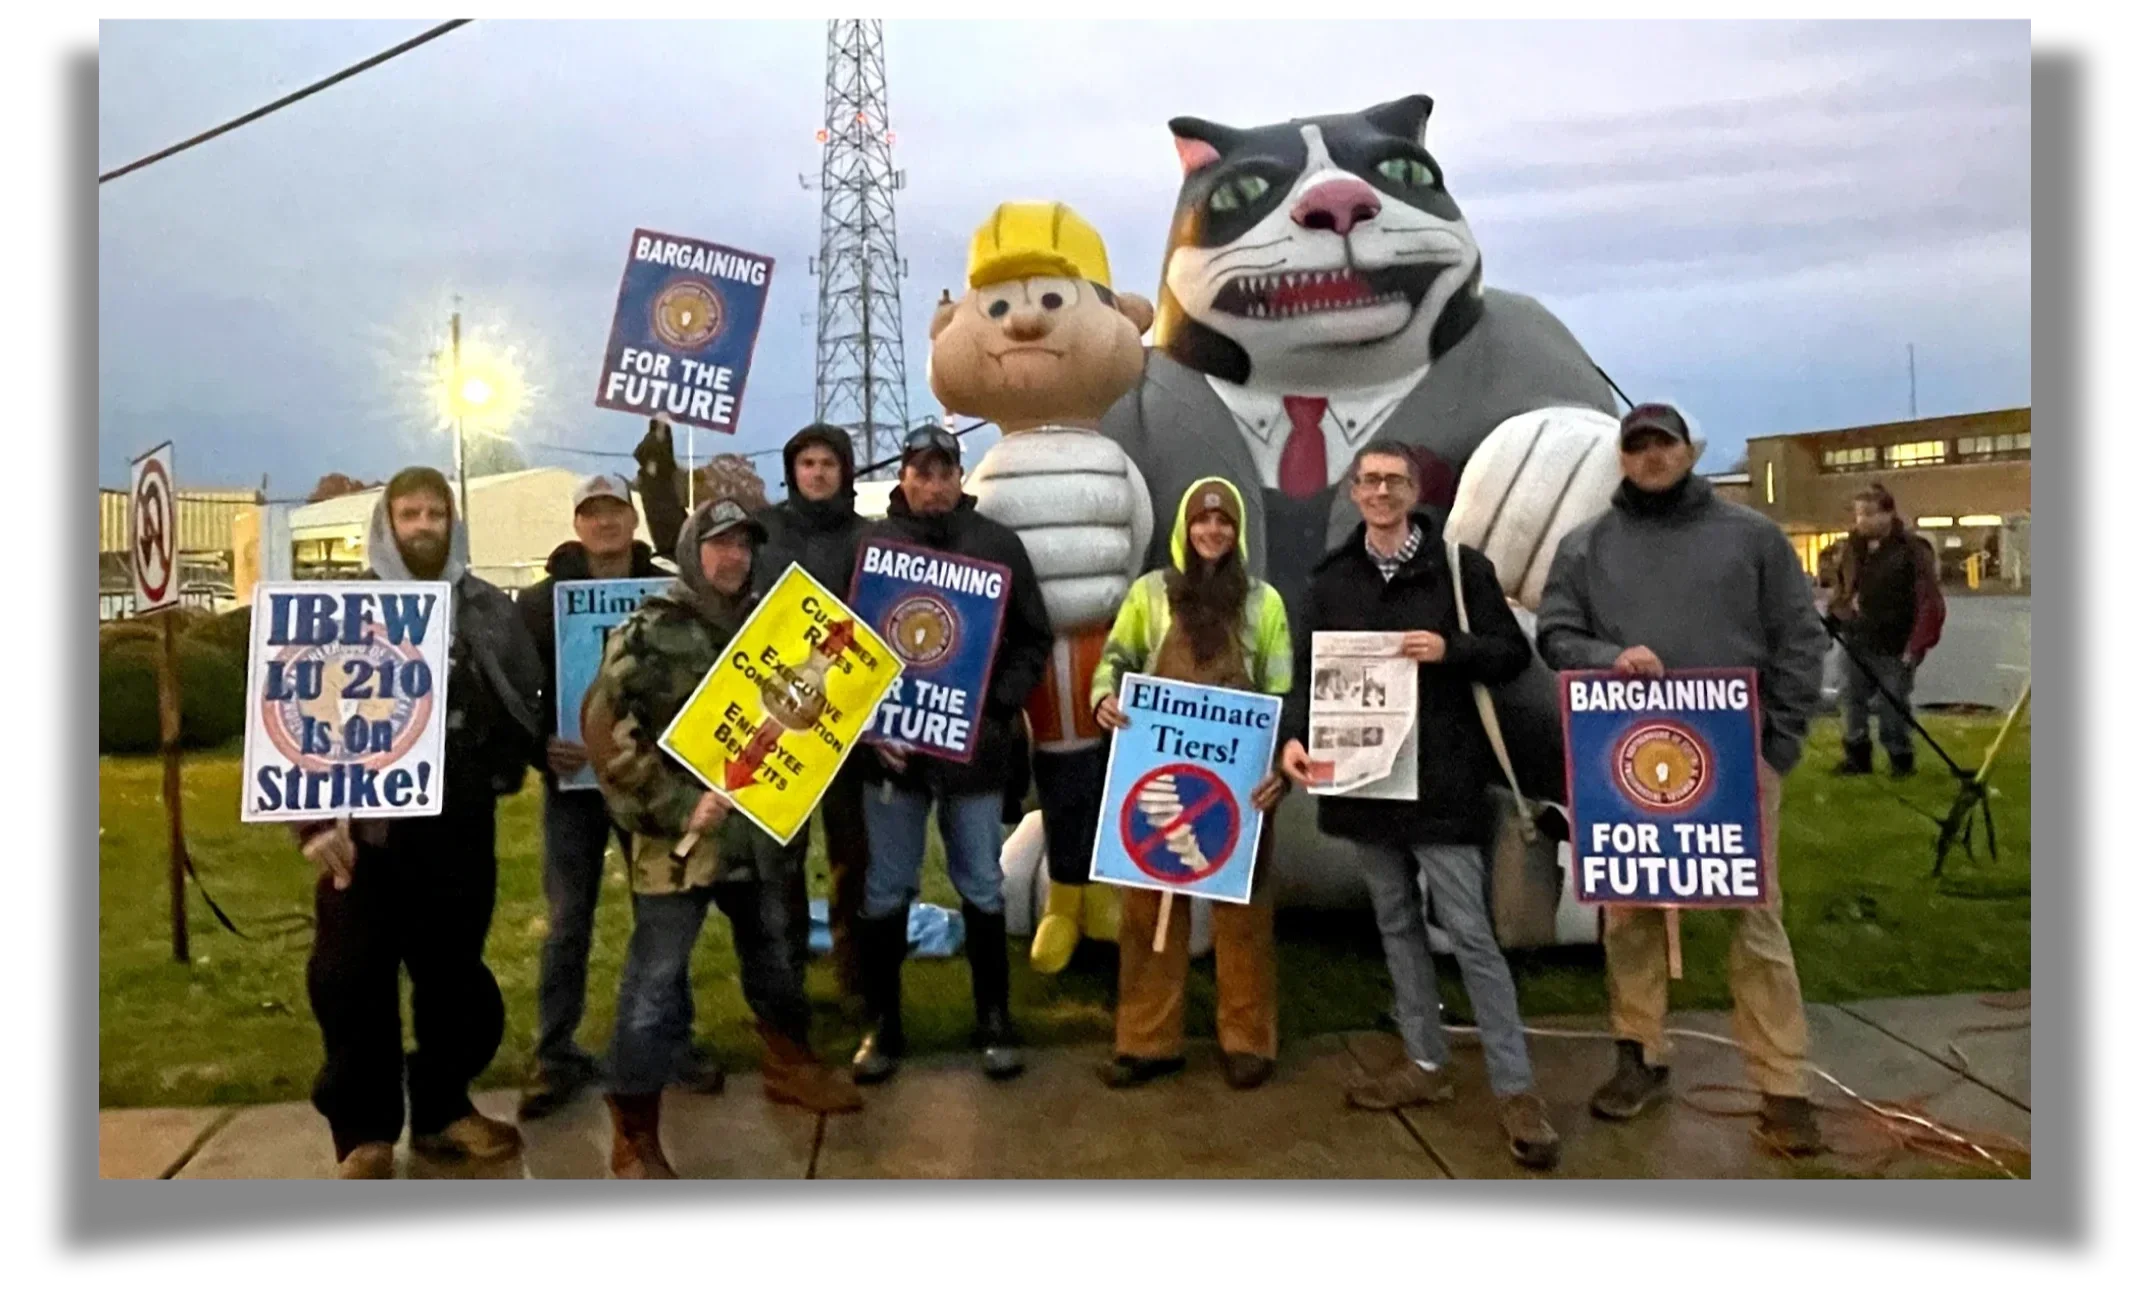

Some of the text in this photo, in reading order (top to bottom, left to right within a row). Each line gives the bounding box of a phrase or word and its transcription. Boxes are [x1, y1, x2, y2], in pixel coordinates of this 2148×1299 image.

[634, 236, 767, 286] BARGAINING
[620, 348, 733, 391] FOR THE
[605, 371, 735, 424] FUTURE
[863, 547, 1002, 599] BARGAINING
[267, 593, 437, 645] IBEW
[567, 588, 645, 615] Elim
[266, 659, 432, 700] LU 210
[915, 679, 966, 715] THE
[1570, 679, 1749, 711] BARGAINING
[1131, 683, 1270, 730] Eliminate
[301, 714, 393, 755] Is On
[1151, 724, 1239, 764] Tiers!
[256, 761, 431, 811] Strike!
[1592, 823, 1744, 854] FOR THE
[1583, 857, 1759, 897] FUTURE
